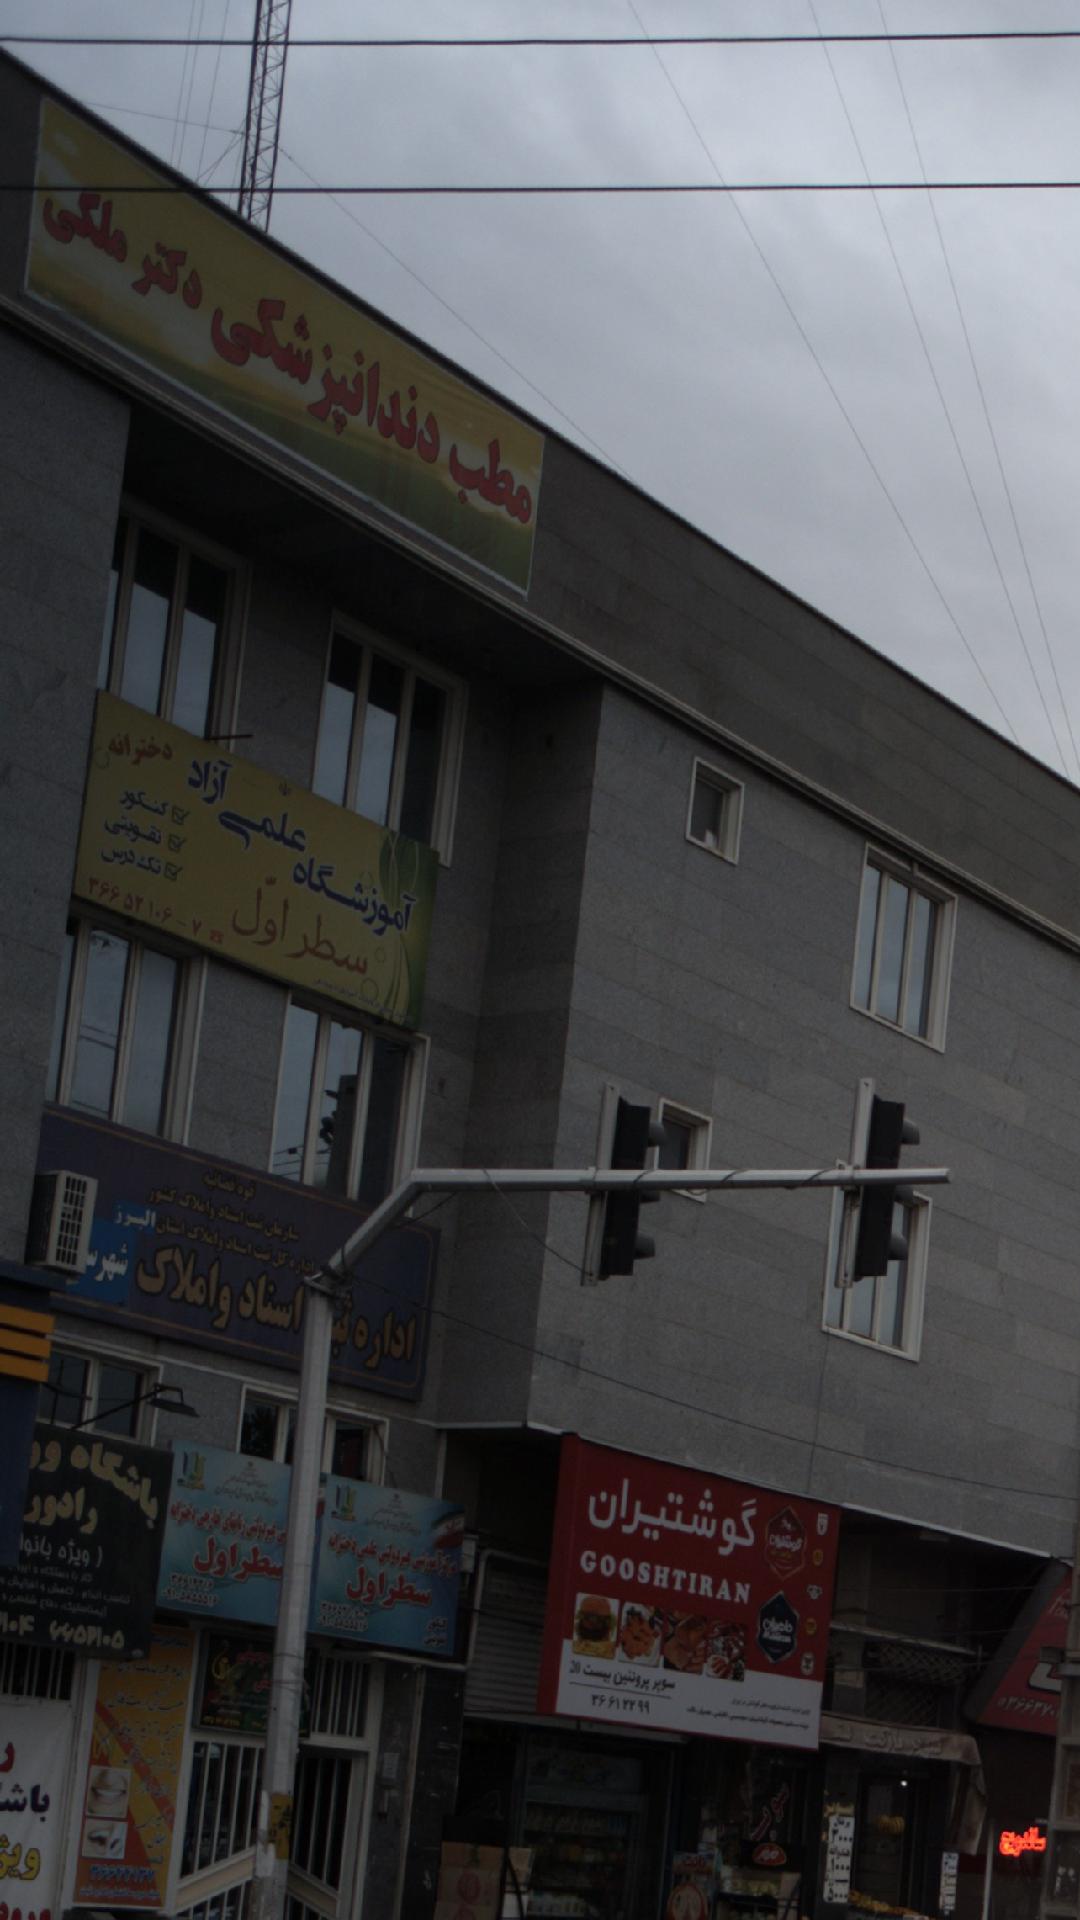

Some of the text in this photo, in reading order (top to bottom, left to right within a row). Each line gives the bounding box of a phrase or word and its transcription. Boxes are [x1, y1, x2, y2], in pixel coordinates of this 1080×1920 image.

[42, 191, 532, 524] مطب دندانپزشکی دکتر ملکی
[108, 733, 173, 765] دخترانه
[119, 790, 169, 817] کنکور
[103, 816, 163, 845] تقویتی
[187, 760, 416, 936] آموزشگاه علمی آزاد
[100, 847, 136, 865] درس
[287, 914, 369, 976] سطر
[148, 1184, 177, 1204] کشور
[113, 1203, 157, 1230] البرز
[156, 1215, 185, 1235] استان
[237, 1270, 305, 1333] اسناد
[353, 1311, 417, 1371] اداره
[70, 1441, 159, 1530] باشگاه
[587, 1477, 758, 1556] گوشتیران
[193, 1535, 238, 1578] اول
[345, 1563, 386, 1605] اول
[380, 1572, 433, 1609] سطر
[579, 1549, 753, 1606] GOOSHTIRAN
[583, 1664, 612, 1683] بیست
[651, 1677, 676, 1691] سوپر
